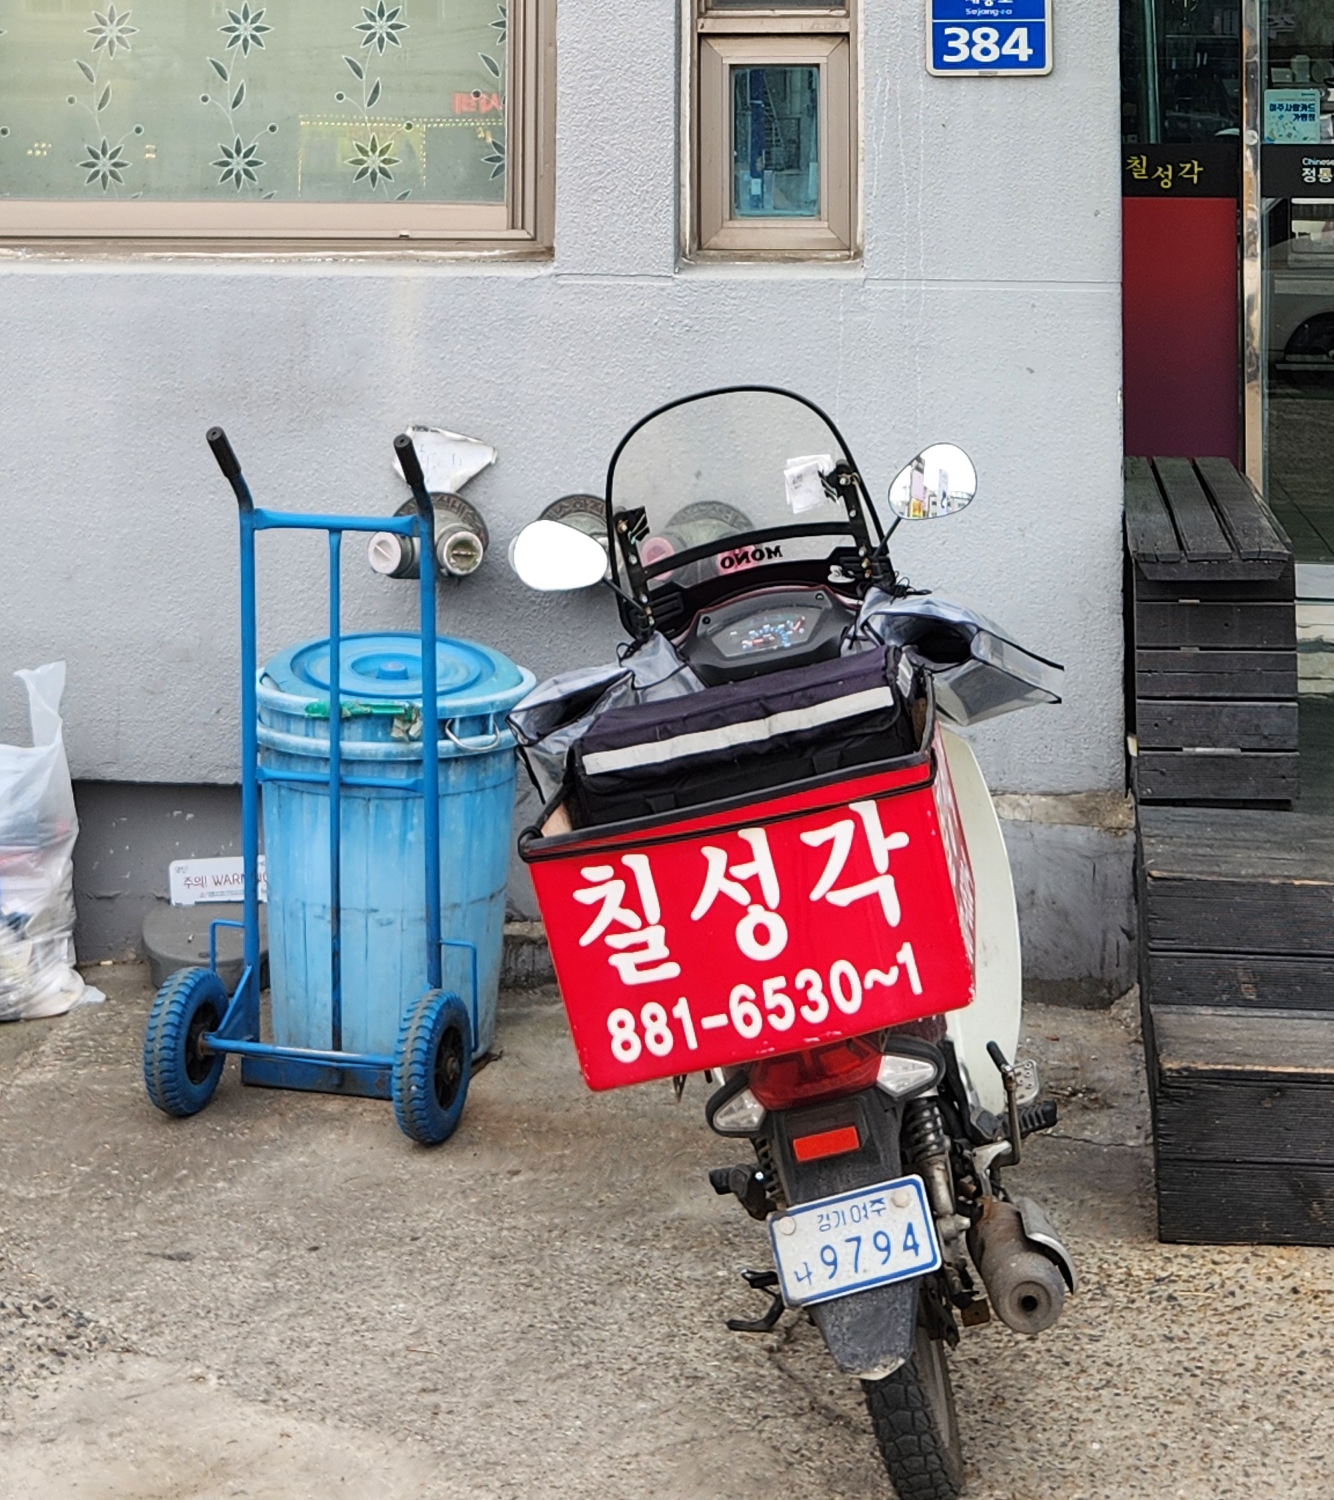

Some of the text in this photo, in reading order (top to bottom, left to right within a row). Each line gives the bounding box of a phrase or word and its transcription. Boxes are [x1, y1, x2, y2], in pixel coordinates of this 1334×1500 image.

[965, 7, 1013, 17] Sejong-ro
[942, 26, 1033, 63] 384
[1125, 154, 1204, 189] 칠성각
[572, 799, 910, 986] 칠성각
[606, 942, 924, 1064] 881-6530~1
[819, 1221, 920, 1281] 9794
